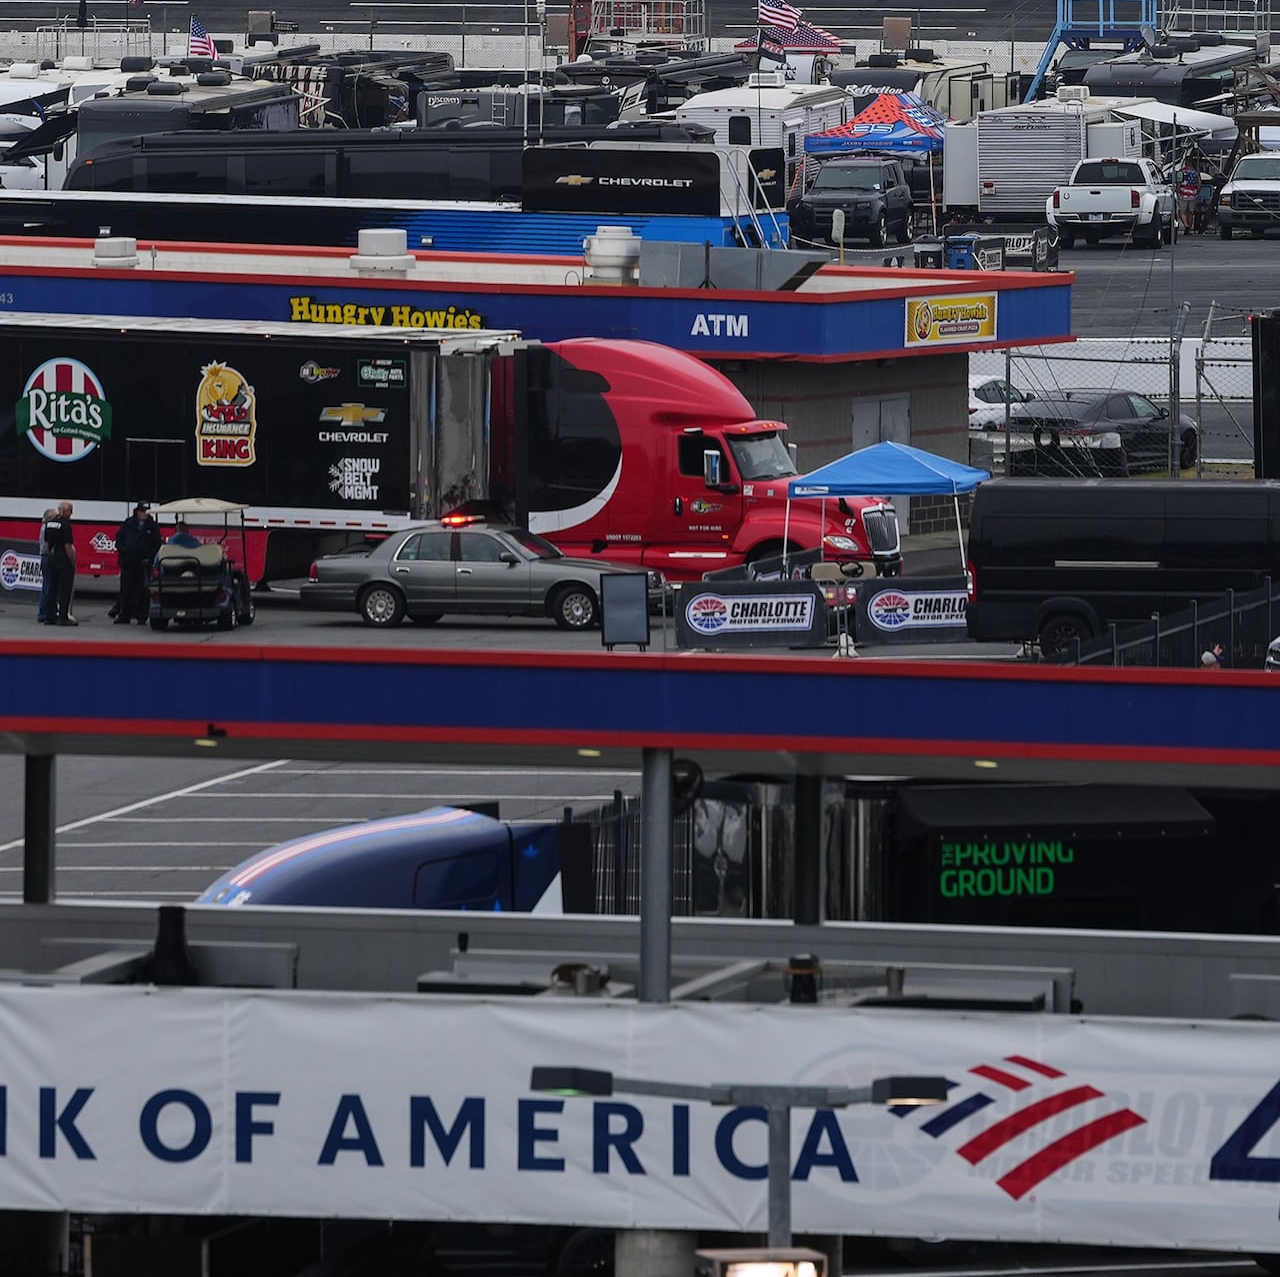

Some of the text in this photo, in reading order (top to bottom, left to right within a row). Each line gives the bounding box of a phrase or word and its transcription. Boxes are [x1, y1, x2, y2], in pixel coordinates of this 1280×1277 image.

[845, 84, 904, 95] Reflection
[599, 177, 693, 187] CHEVROLET
[290, 297, 385, 326] Hungry
[691, 314, 749, 337] ATM
[29, 389, 103, 429] Rita's
[201, 424, 251, 435] INSURANCE
[319, 431, 389, 443] CHEVROLET
[202, 439, 250, 459] KING
[344, 458, 380, 472] SNOW
[344, 472, 372, 486] BELT
[344, 486, 378, 500] MGMT
[844, 518, 857, 527] 07
[730, 601, 807, 618] CHARLOTTE
[940, 867, 1055, 898] GROUND
[138, 1089, 281, 1164] OF
[317, 1094, 860, 1184] AMERICA
